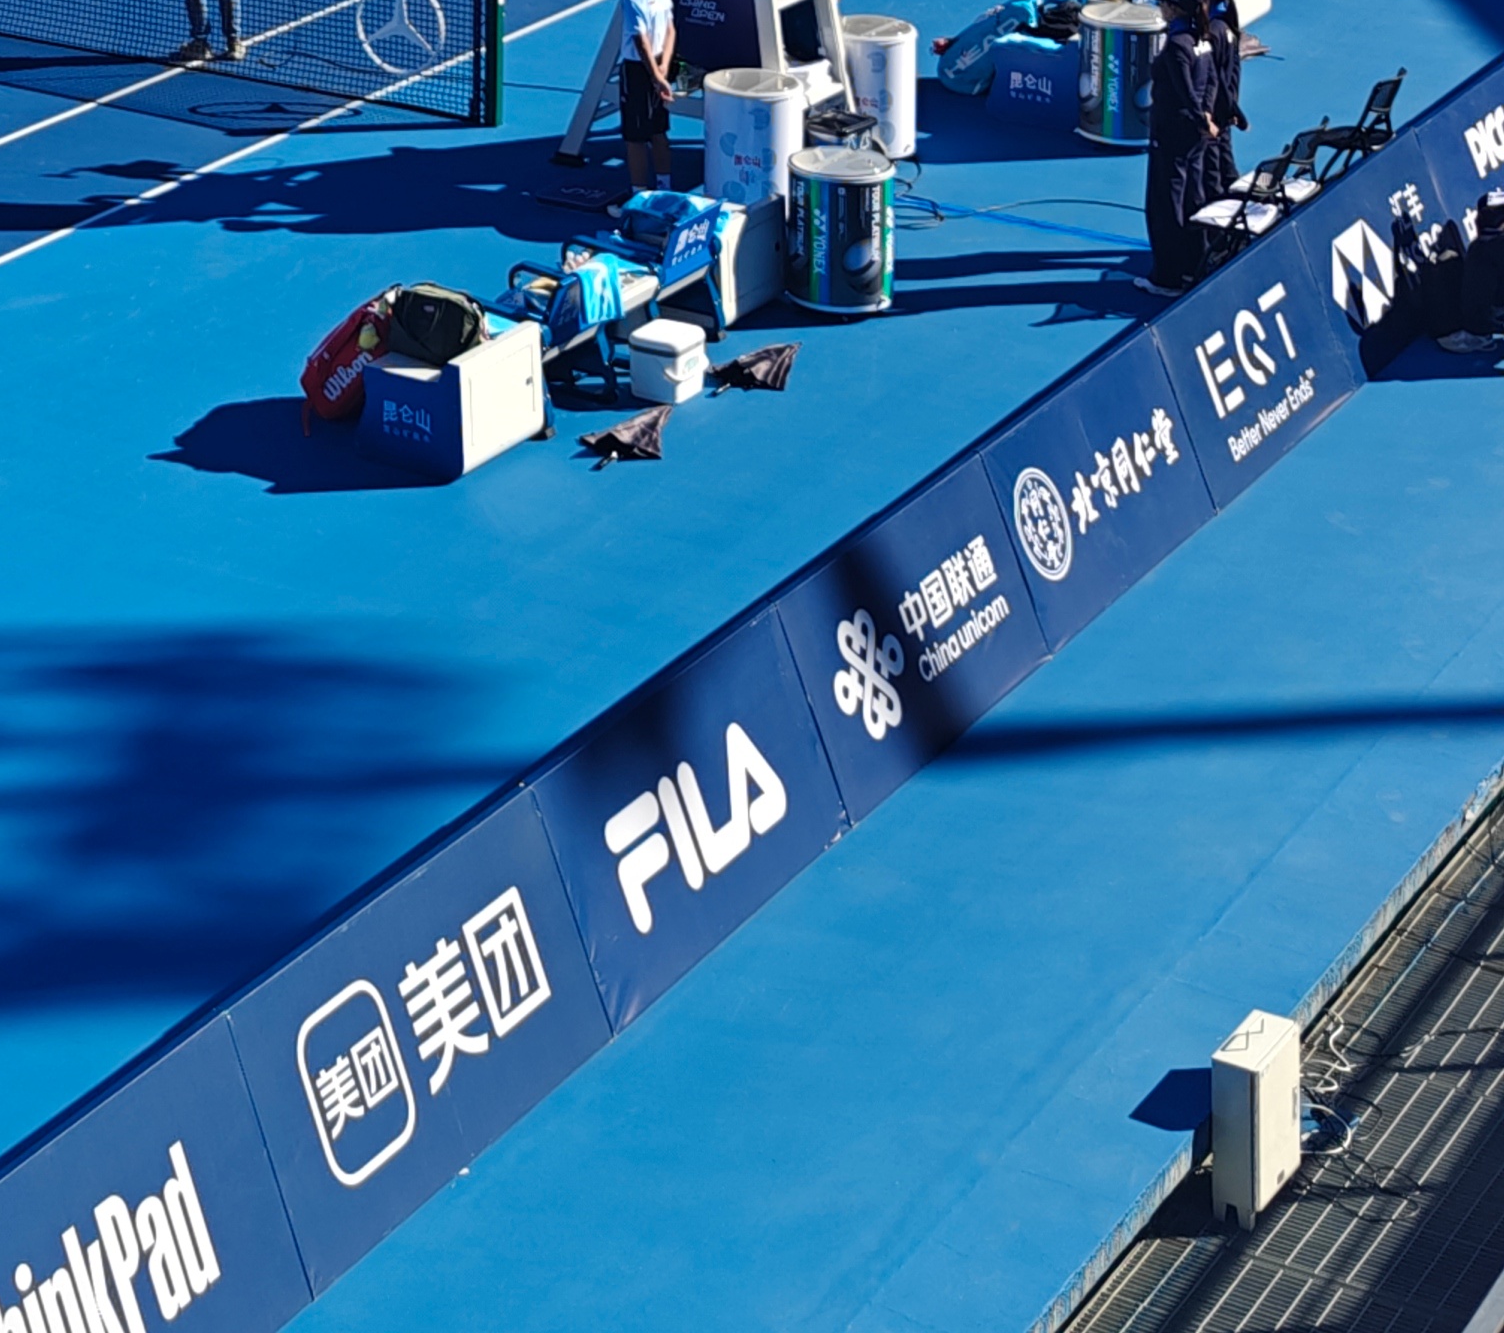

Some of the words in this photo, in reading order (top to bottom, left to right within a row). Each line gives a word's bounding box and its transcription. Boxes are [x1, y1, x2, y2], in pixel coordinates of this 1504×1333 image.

[691, 7, 725, 23] OPEN
[944, 18, 1020, 79] HEAD
[1010, 71, 1053, 96] 昆仑山
[1107, 77, 1119, 113] YONEX
[813, 235, 826, 275] YONEX
[323, 351, 374, 402] Wilson
[1195, 281, 1296, 420] EQT
[383, 400, 432, 433] 昆仑山
[1227, 423, 1263, 463] Better
[1258, 398, 1291, 436] Never
[1285, 376, 1315, 412] Ends
[1071, 408, 1179, 535] 北京同仁堂
[898, 534, 998, 642] 中国联通
[919, 632, 960, 682] China
[957, 595, 1010, 651] unicom
[604, 721, 787, 935] FILA
[397, 885, 551, 1097] 美团
[315, 1025, 399, 1140] 美团
